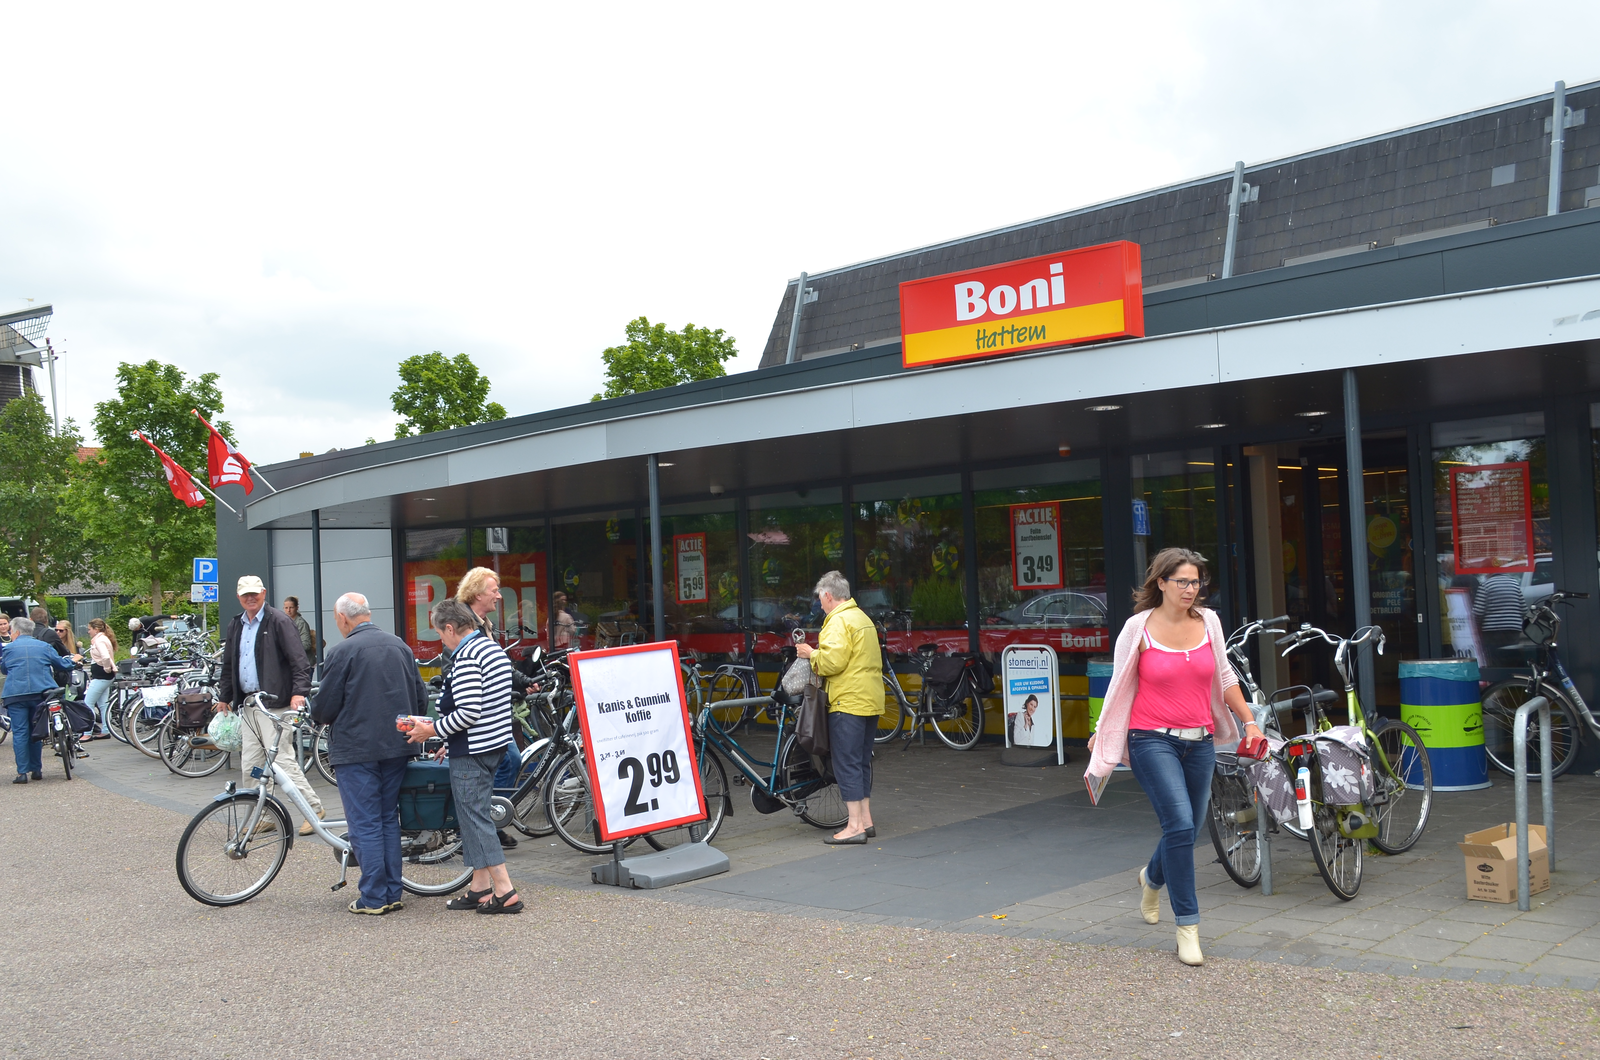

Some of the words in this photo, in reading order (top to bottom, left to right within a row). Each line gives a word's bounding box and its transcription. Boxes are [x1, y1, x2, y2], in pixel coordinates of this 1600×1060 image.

[954, 262, 1066, 321] Boni
[975, 323, 1047, 350] Hattem
[1018, 507, 1053, 523] ACTIE
[680, 538, 703, 551] ACTIE
[199, 561, 213, 580] P
[1022, 555, 1053, 584] 3.49
[683, 577, 704, 600] 5.99
[414, 563, 538, 641] Bni
[1061, 631, 1102, 648] Boni
[1009, 656, 1048, 669] stomerij.nl
[597, 698, 625, 714] Kanis
[626, 699, 633, 709] &
[634, 691, 671, 708] Gunnink
[625, 708, 652, 724] Koffie
[618, 749, 681, 817] 2.99
